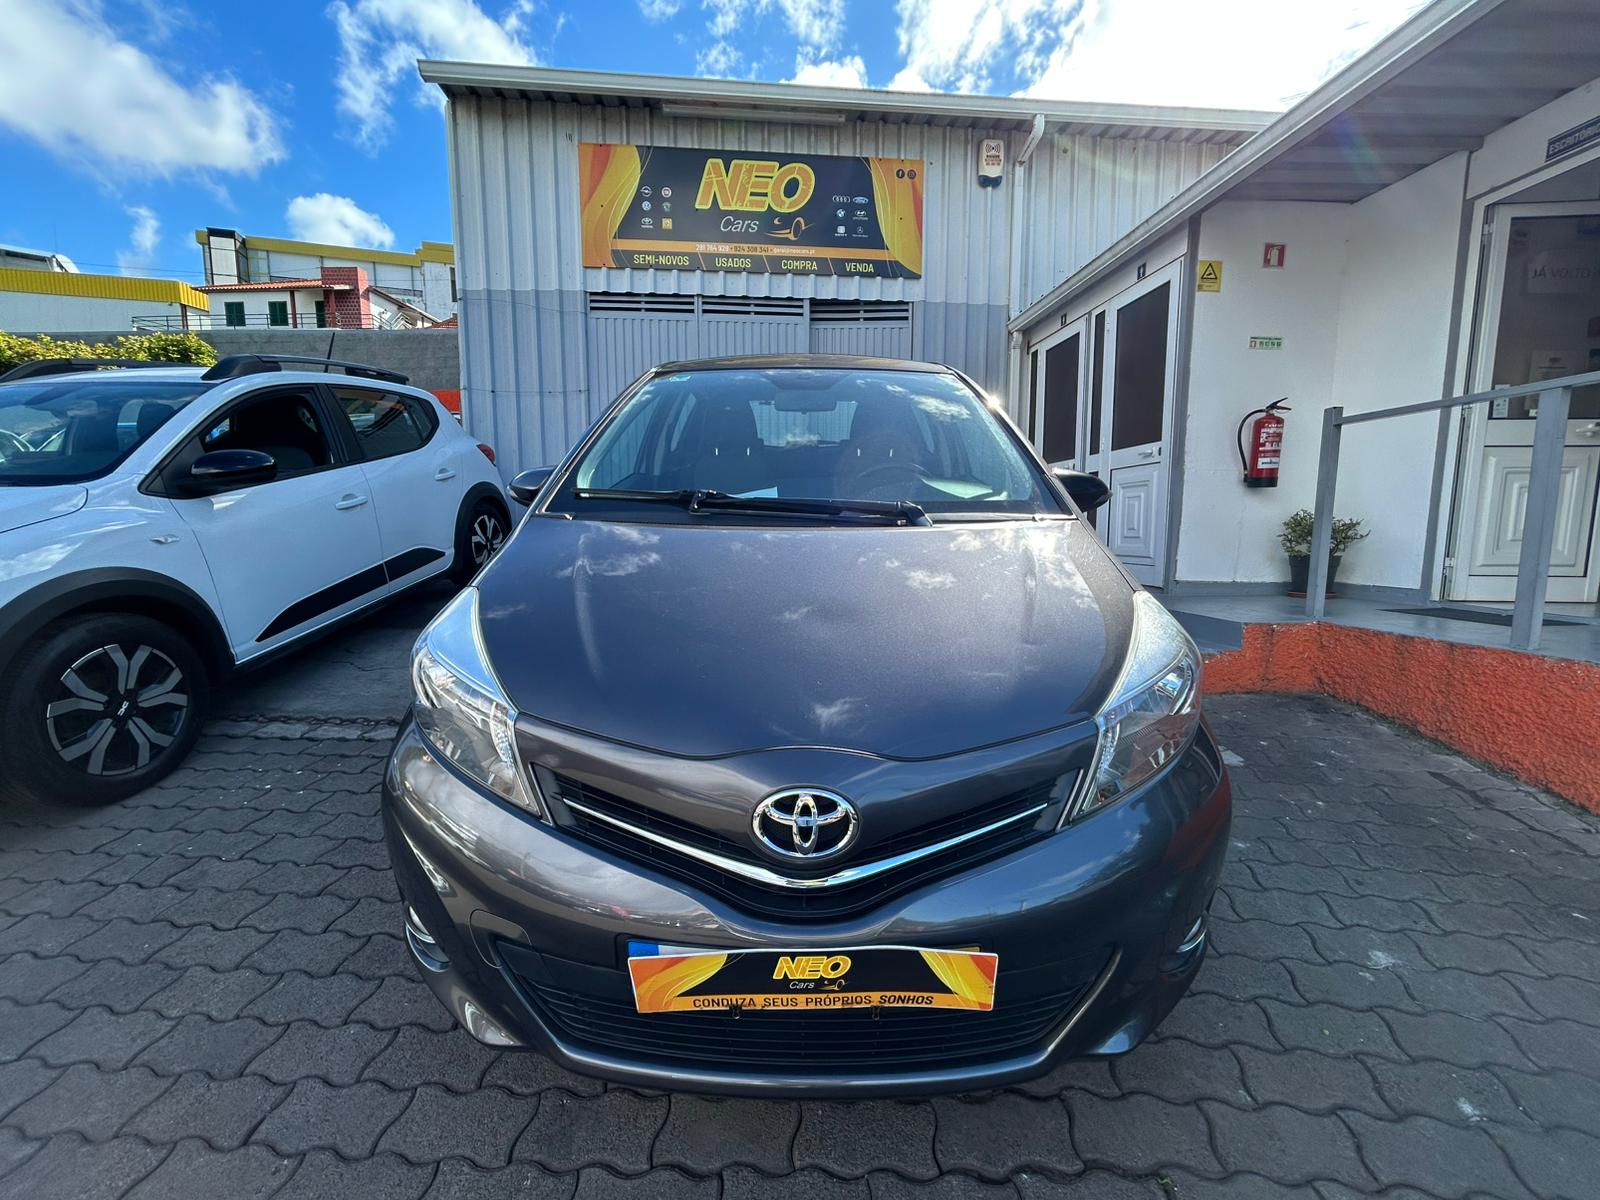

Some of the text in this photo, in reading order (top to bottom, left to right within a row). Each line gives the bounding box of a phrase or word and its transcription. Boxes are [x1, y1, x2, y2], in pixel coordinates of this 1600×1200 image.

[695, 158, 815, 213] NEO
[720, 215, 759, 232] Cars
[633, 254, 689, 266] SEMI-NOVOS
[715, 257, 751, 268] USADOS
[781, 260, 818, 271] COMPRA
[845, 262, 874, 273] VENDA
[773, 955, 851, 979] NEO
[789, 980, 815, 989] Cars
[693, 994, 934, 1008] CONDUZA SEUS PRÓPRIOS SONHOS
